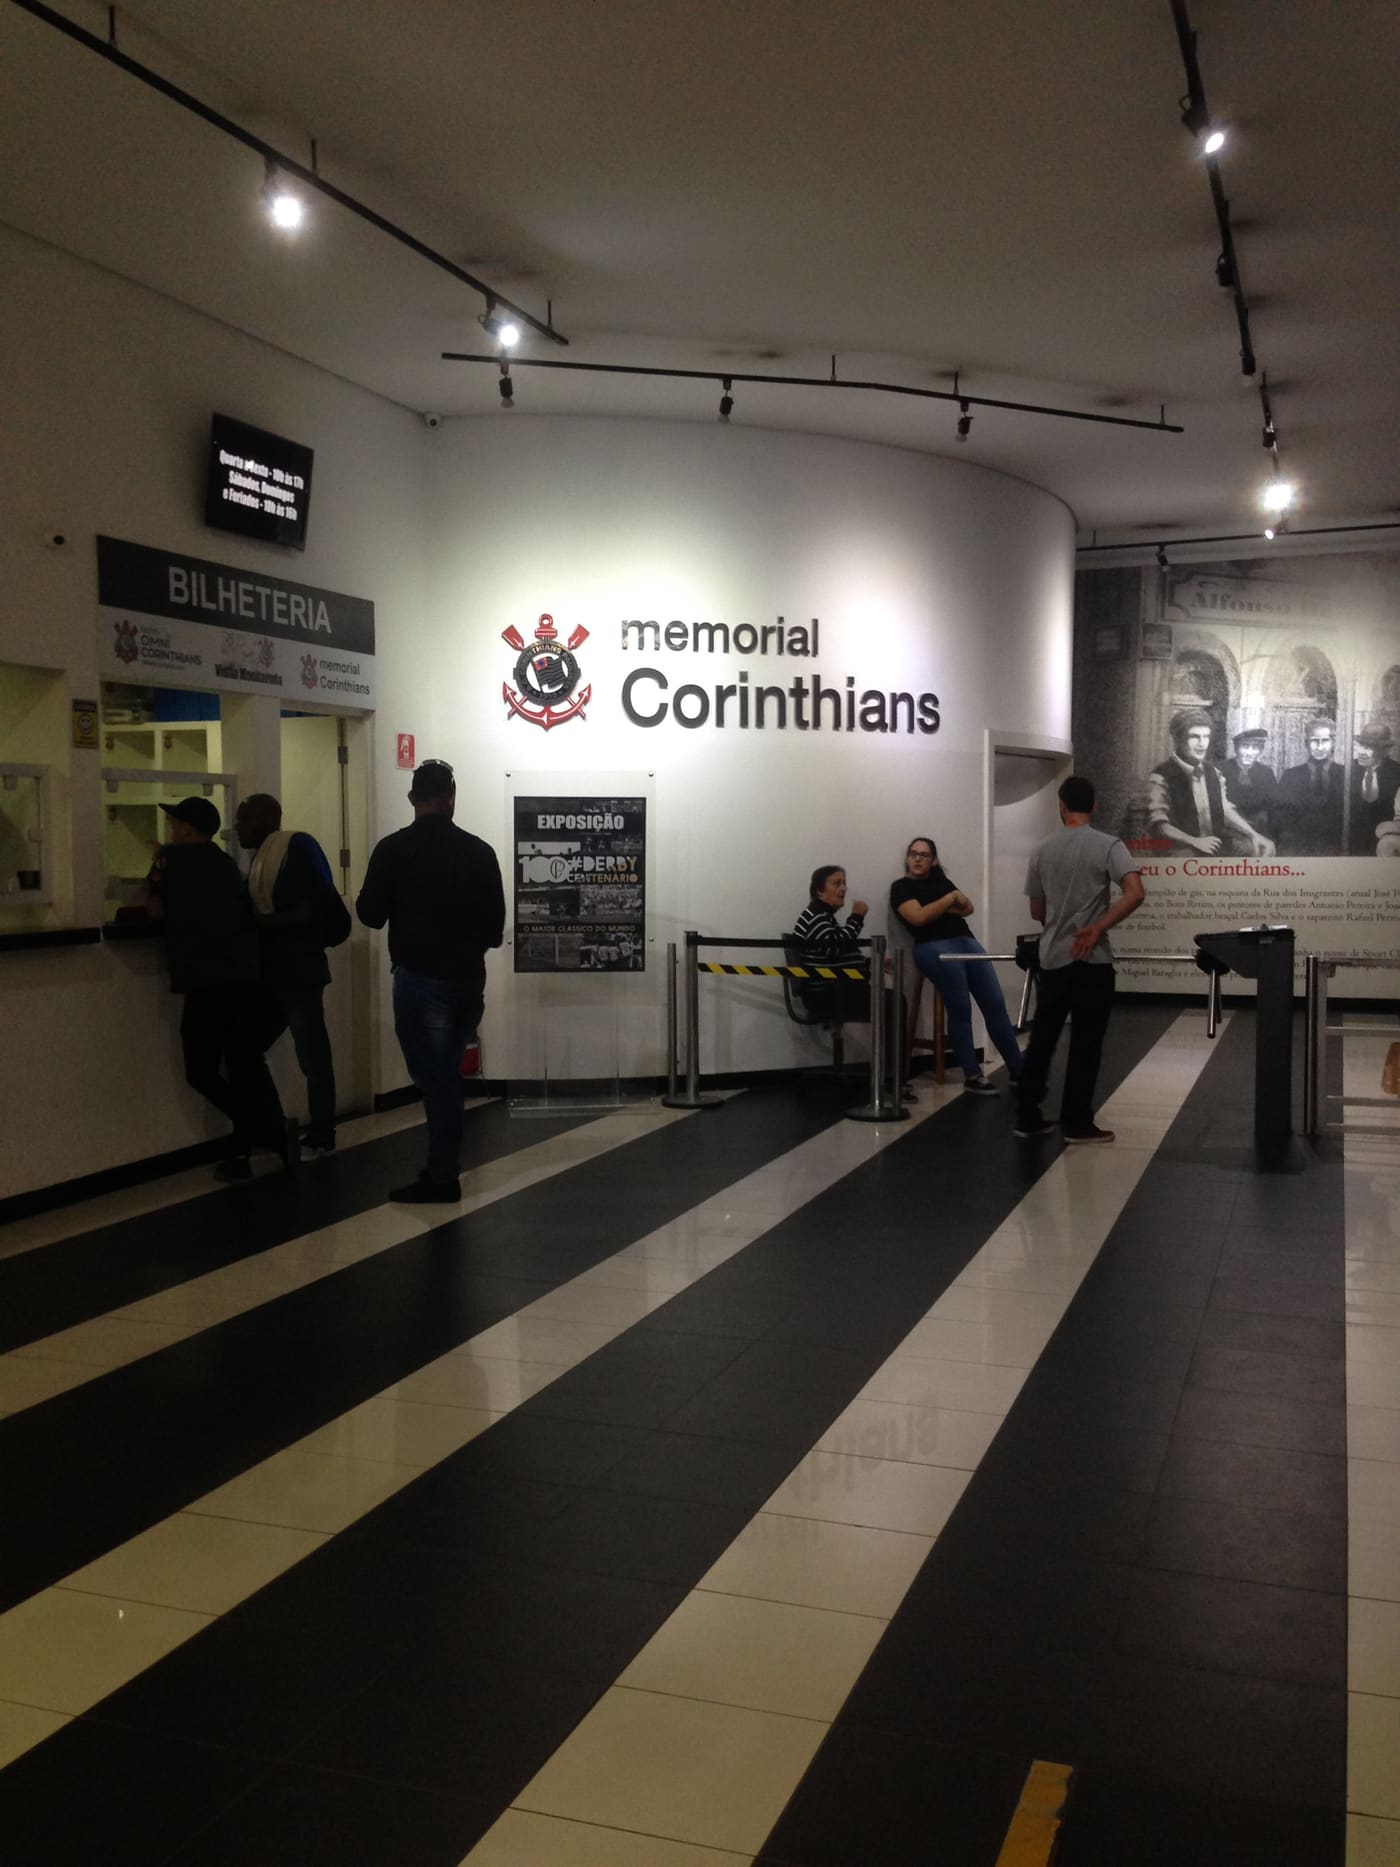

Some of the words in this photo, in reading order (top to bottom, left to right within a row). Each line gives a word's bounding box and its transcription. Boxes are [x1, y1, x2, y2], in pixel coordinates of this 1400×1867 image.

[168, 564, 333, 634] BILHETERIA
[621, 616, 819, 657] memorial
[141, 647, 202, 665] CORINTHIANS
[319, 658, 361, 676] memorial
[319, 675, 370, 696] Corinthians
[621, 667, 940, 735] Corinthians
[537, 812, 625, 832] EXPOSIÇÃO
[567, 855, 638, 872] #DERBY
[1166, 865, 1176, 876] o
[1183, 859, 1305, 877] Corinthians...
[1263, 888, 1280, 897] Rua
